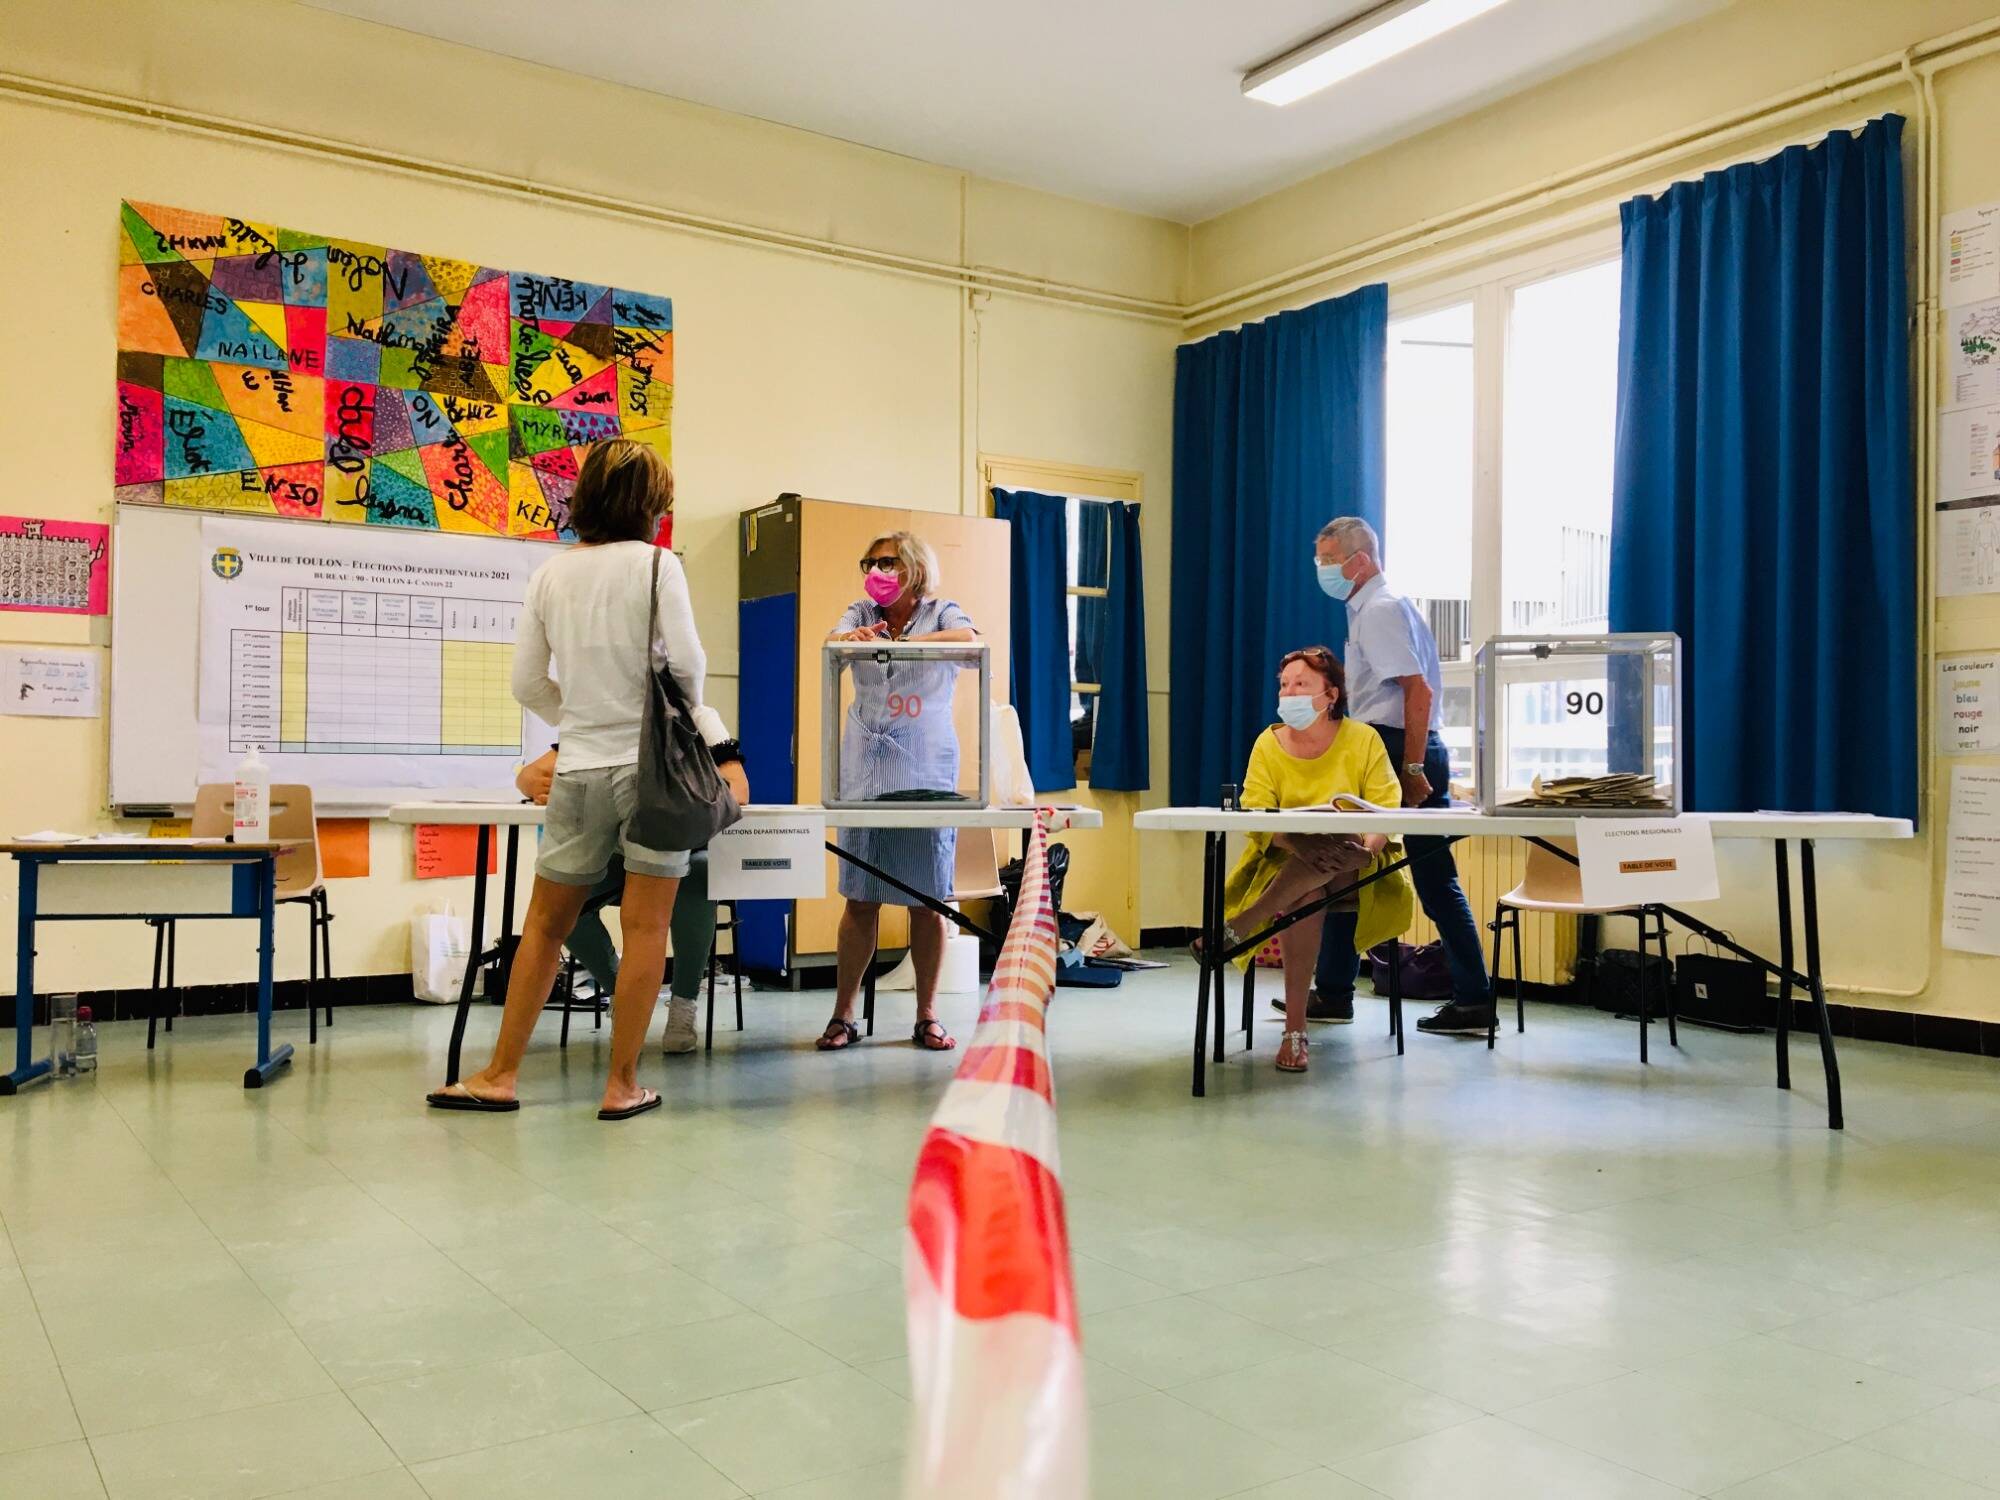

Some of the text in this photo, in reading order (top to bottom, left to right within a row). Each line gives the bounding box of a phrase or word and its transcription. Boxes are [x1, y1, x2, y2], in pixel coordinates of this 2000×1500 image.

[141, 282, 228, 315] CHARLES
[249, 552, 278, 563] VILLE
[281, 556, 293, 564] DE
[295, 556, 342, 567] TOULON
[352, 560, 403, 572] ELECTIONS
[404, 564, 489, 579] DEPARTEMENTALES
[491, 570, 510, 580] 2021
[314, 572, 348, 581] BUREAU
[371, 576, 405, 585] TOULON
[1942, 662, 1993, 672] Les couleurs
[1952, 680, 1981, 691] jaune
[1566, 692, 1603, 715] 90
[1956, 694, 1978, 703] bleu
[888, 694, 922, 718] 90
[1953, 710, 1983, 720] rouge
[1958, 724, 1979, 733] noir
[1958, 740, 1980, 748] vert
